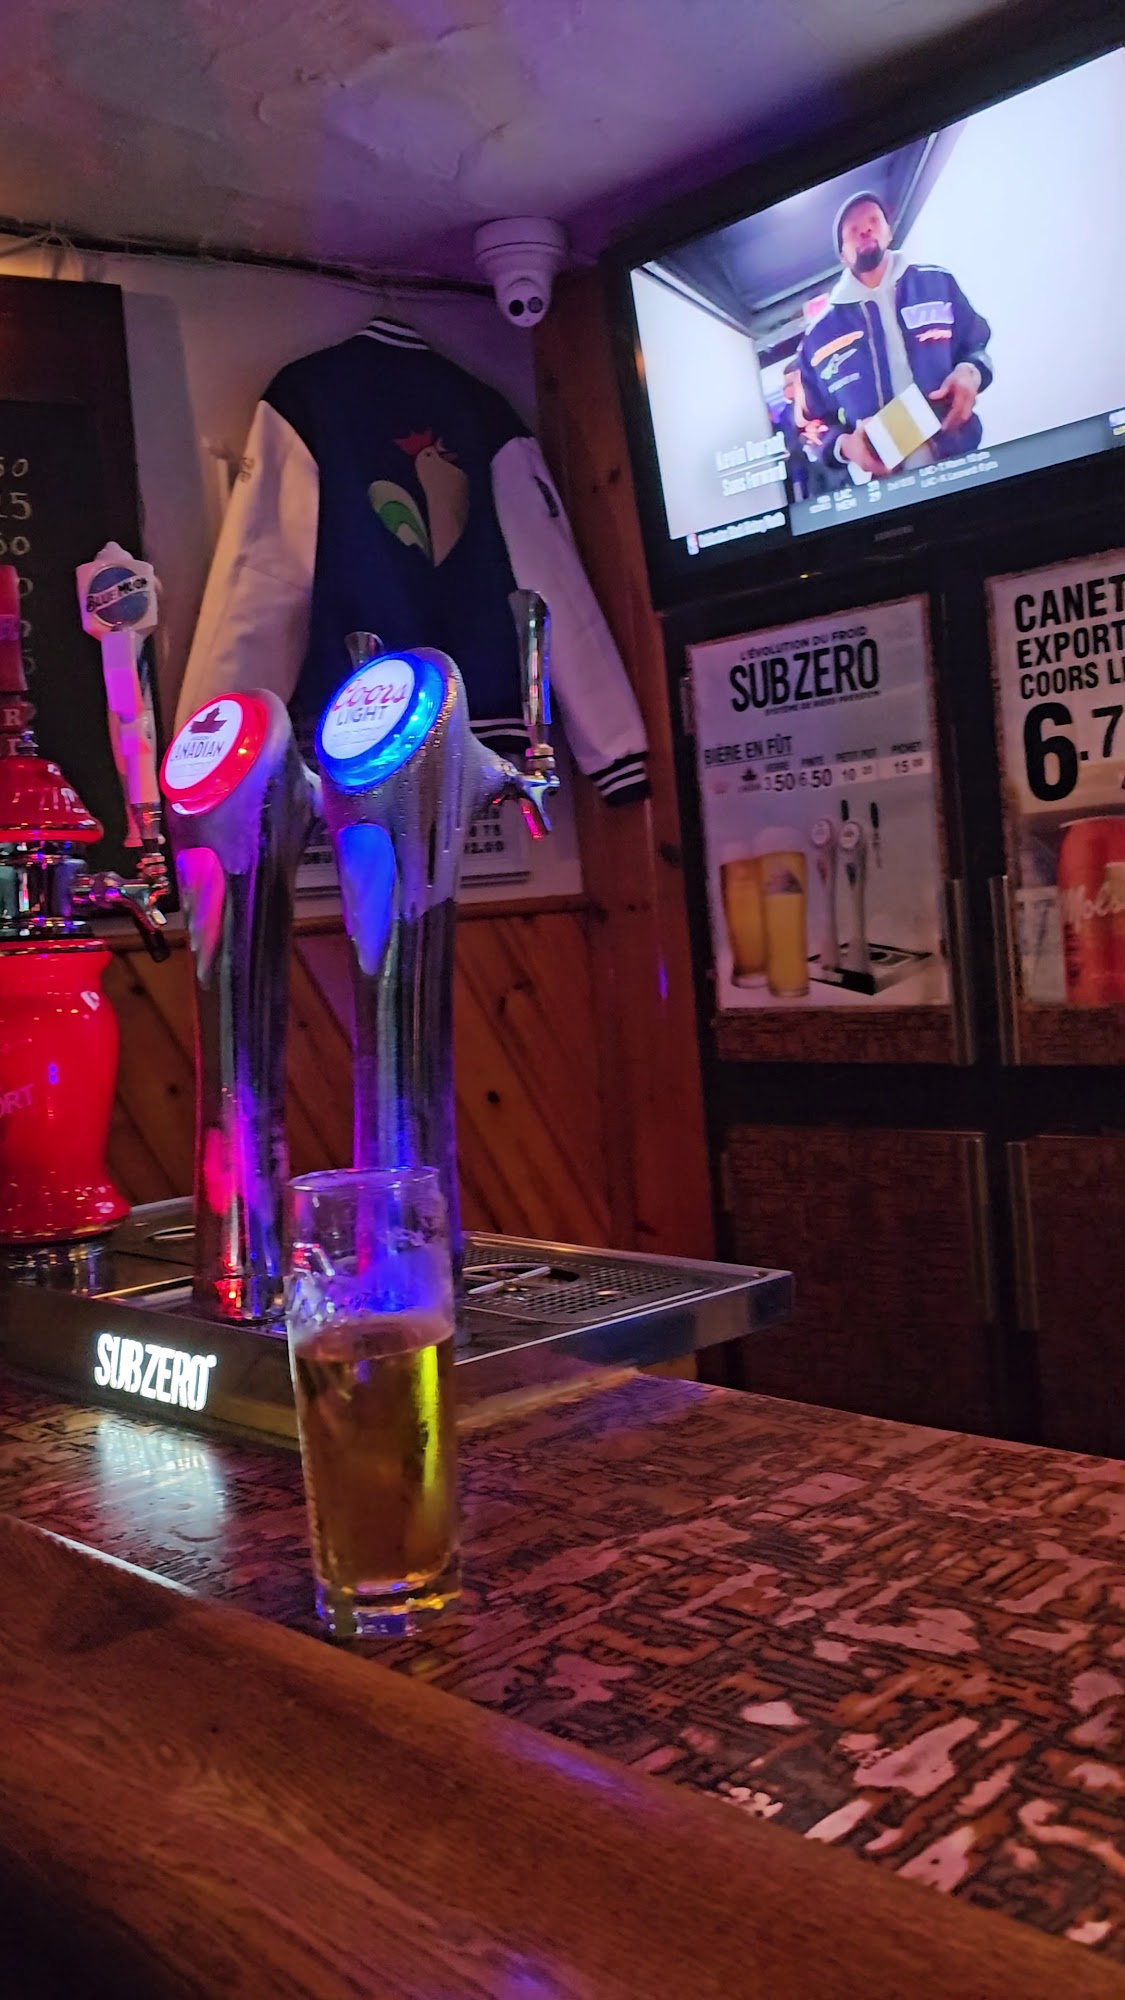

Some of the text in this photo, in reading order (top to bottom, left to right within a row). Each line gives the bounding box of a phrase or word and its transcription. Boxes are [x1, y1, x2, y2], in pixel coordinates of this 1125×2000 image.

[812, 632, 830, 646] DU
[832, 625, 867, 641] FROID
[1017, 620, 1125, 669] EXPORT
[1019, 662, 1099, 700] COORS
[331, 678, 408, 712] Coors
[336, 705, 388, 727] LIGHT
[170, 740, 225, 762] CANADIAN
[745, 739, 763, 759] EN
[766, 733, 793, 755] FÛT
